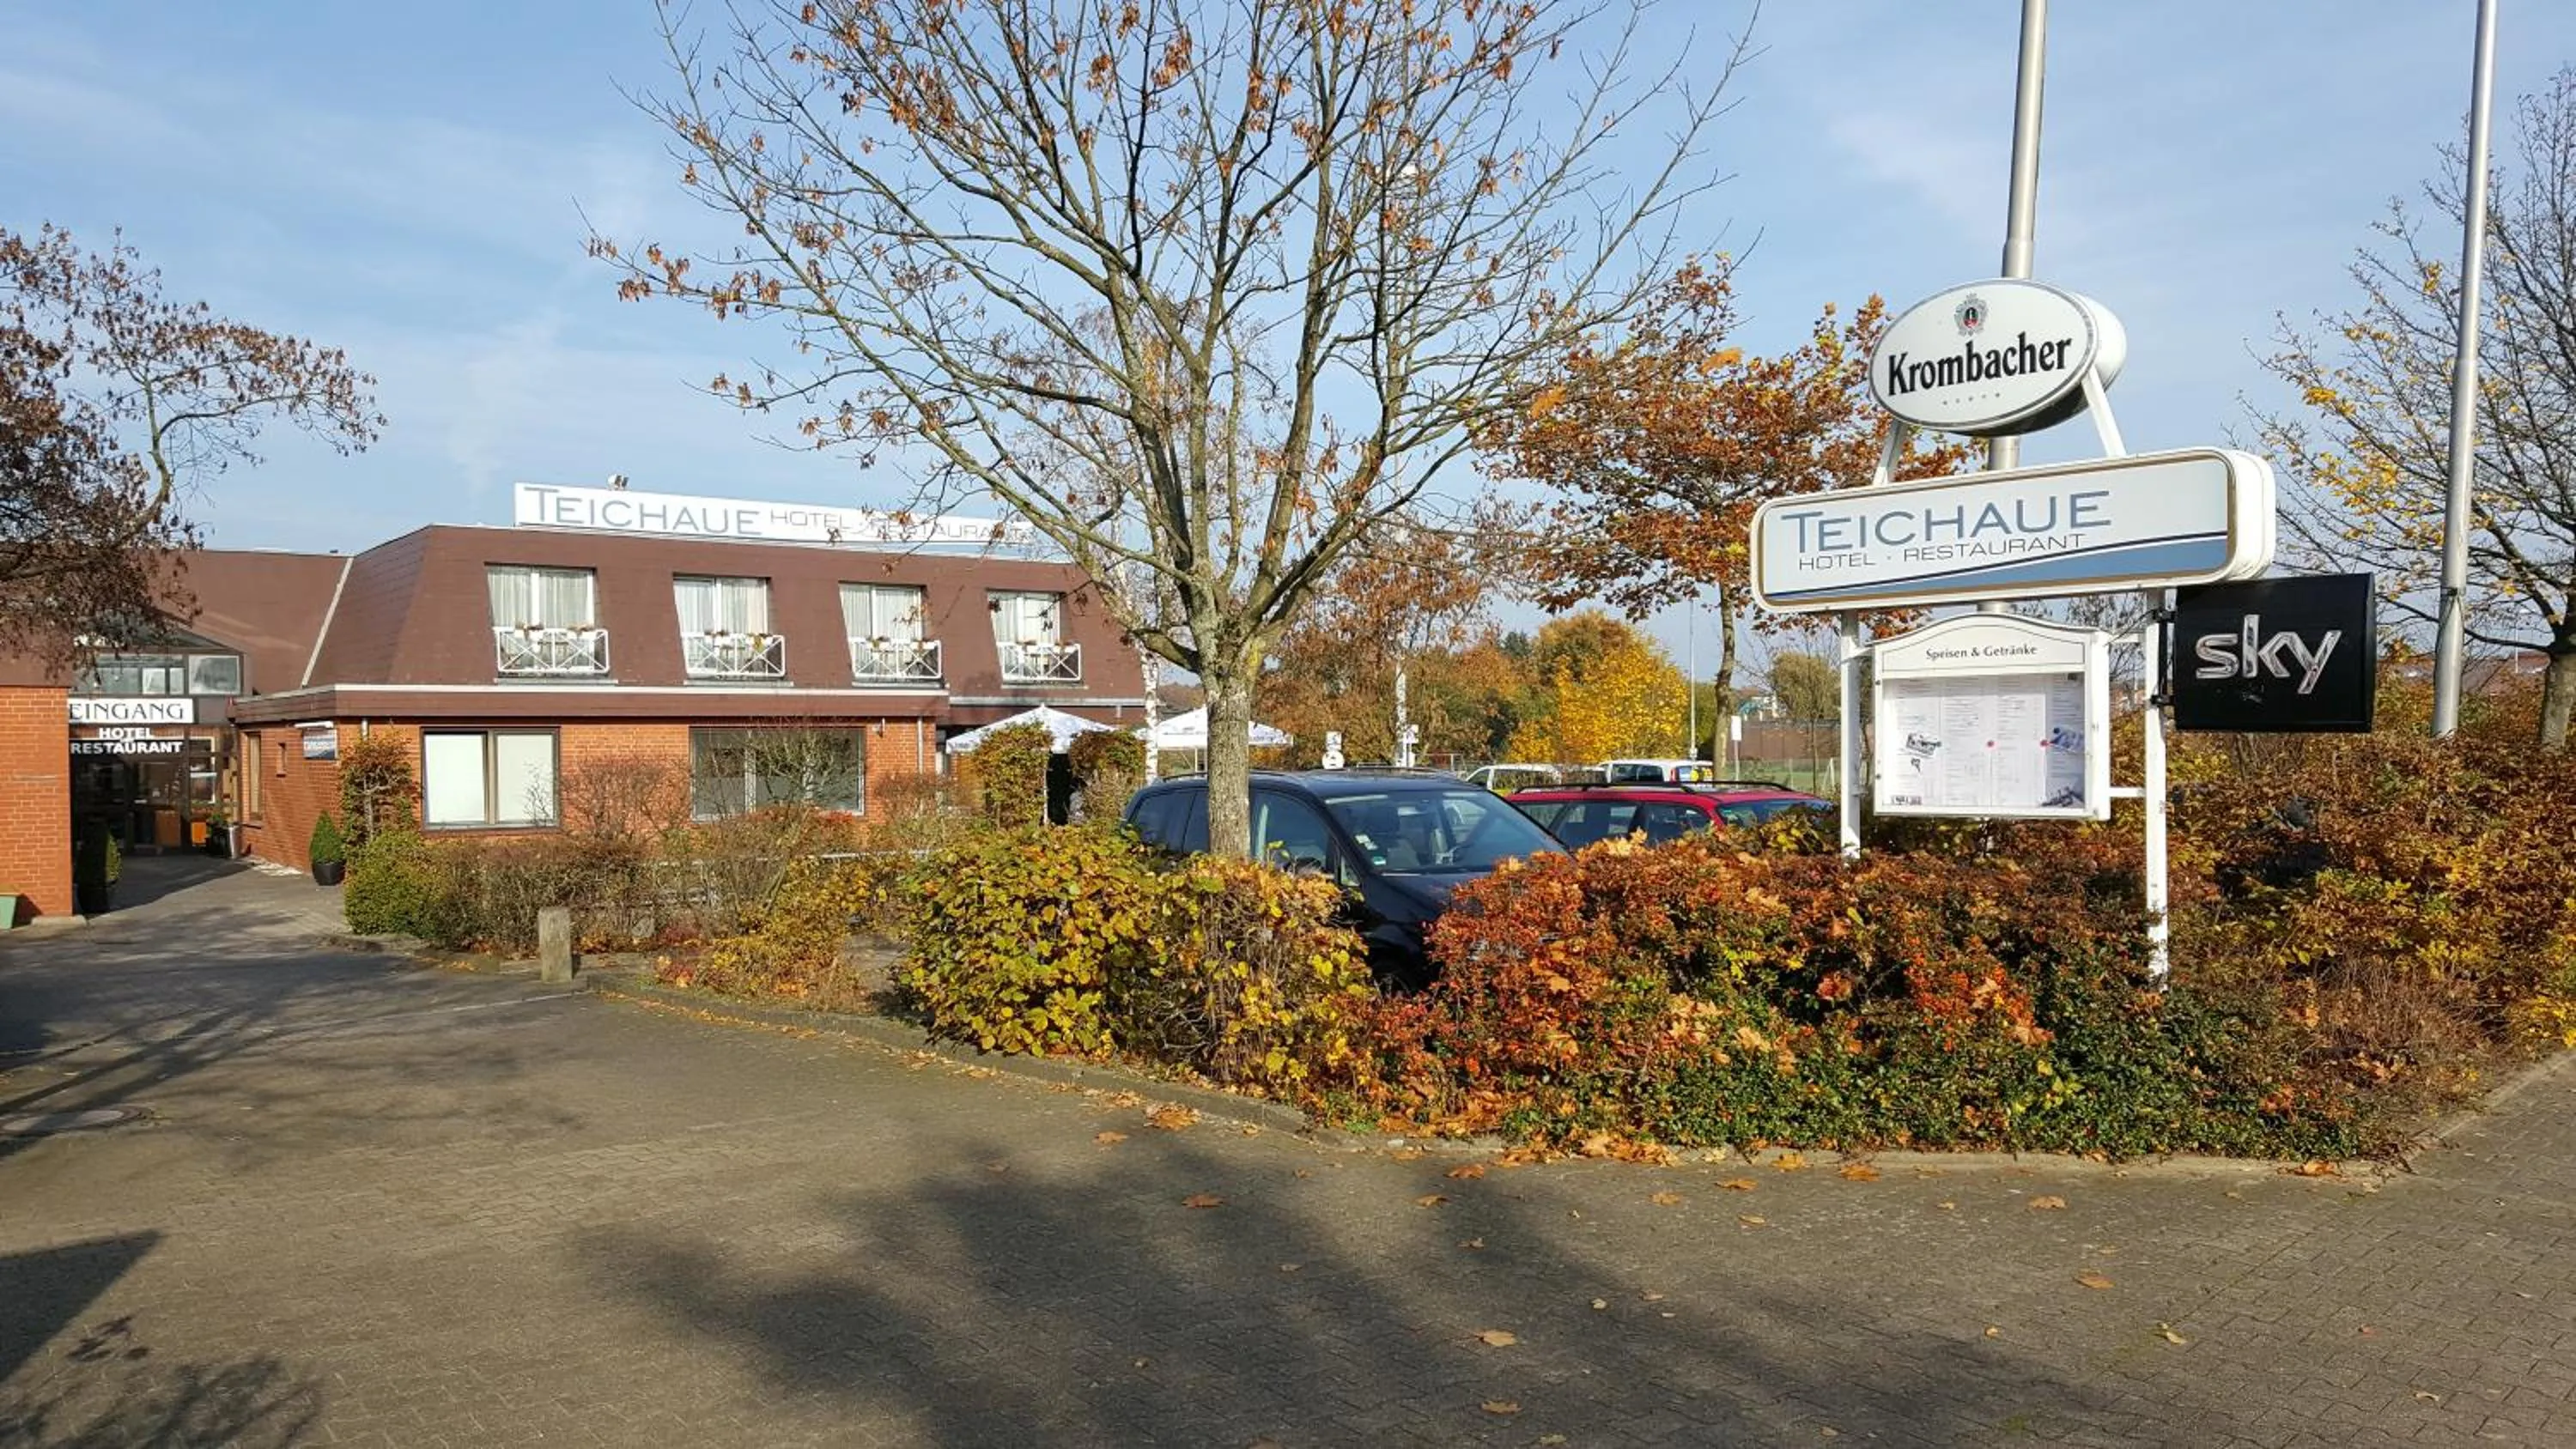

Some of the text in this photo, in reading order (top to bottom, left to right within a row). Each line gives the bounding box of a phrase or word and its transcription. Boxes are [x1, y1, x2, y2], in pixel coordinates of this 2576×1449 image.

[1888, 330, 2072, 396] Krombacher
[524, 487, 762, 536] TEICHAUE
[770, 511, 851, 530] HOTEL
[1781, 490, 2111, 554] TEICHAUE
[1799, 533, 2085, 571] HOTEL RESTAURANT
[1926, 644, 2038, 661] Speisen & Getränke
[2195, 614, 2342, 694] sky
[69, 703, 183, 720] EINGANG
[70, 742, 183, 755] RESTAURANT
[99, 728, 155, 739] HOTEL
